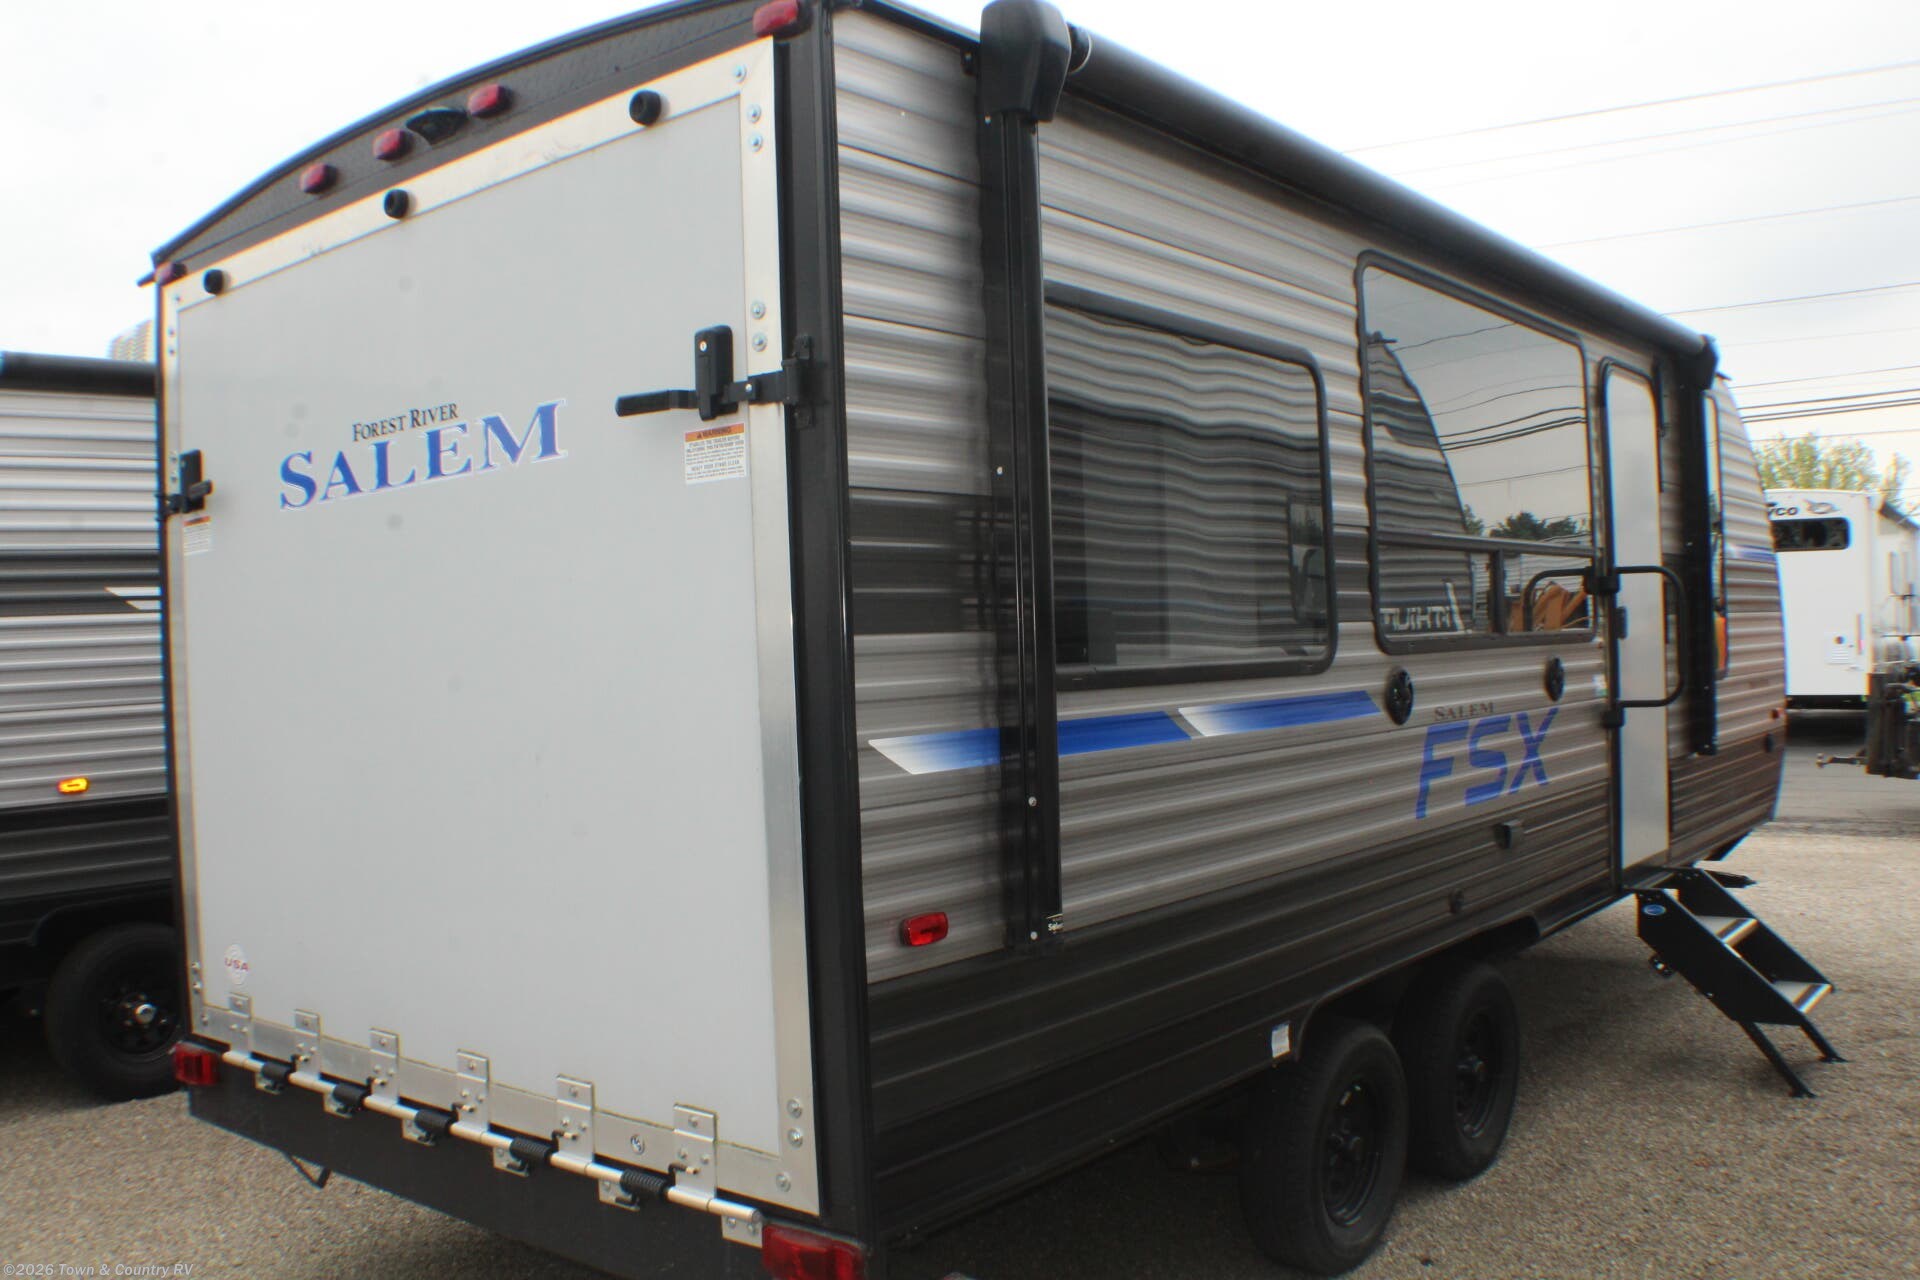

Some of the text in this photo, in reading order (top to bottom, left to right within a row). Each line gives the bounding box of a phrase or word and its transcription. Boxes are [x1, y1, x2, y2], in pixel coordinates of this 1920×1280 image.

[352, 403, 459, 442] FOREST RIVER
[280, 399, 567, 510] SALEM
[1434, 702, 1495, 720] SALEM
[1415, 707, 1559, 819] FSX
[224, 957, 249, 970] USA
